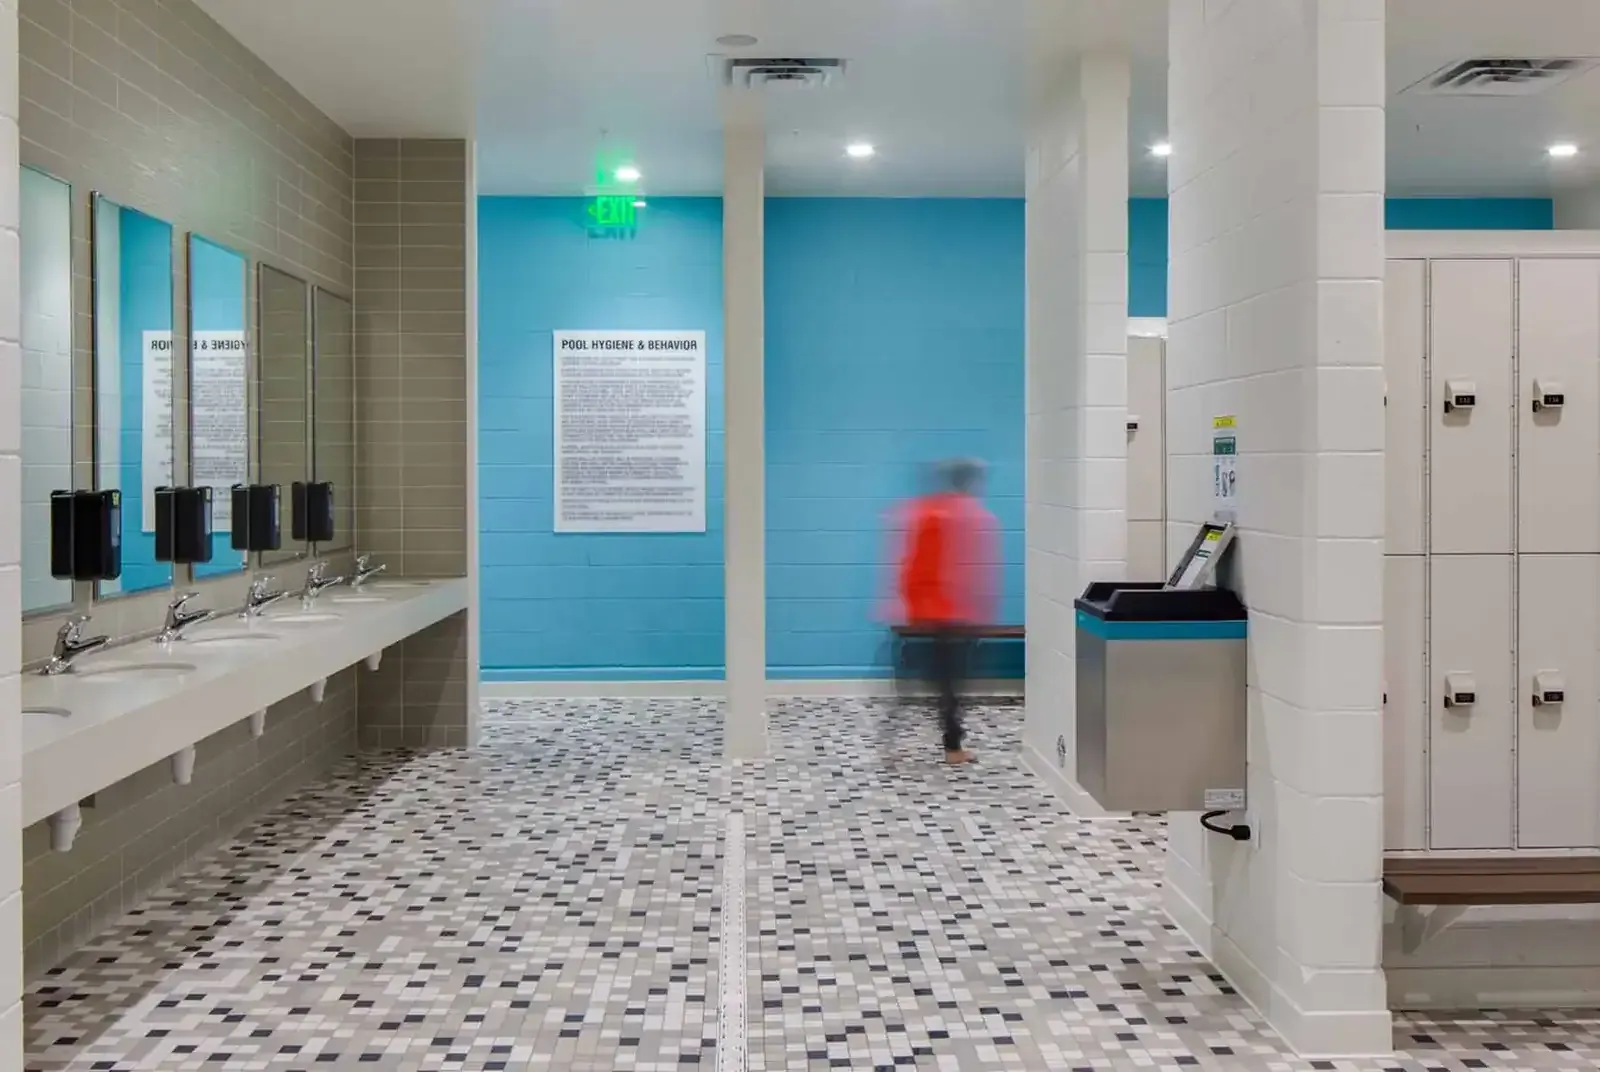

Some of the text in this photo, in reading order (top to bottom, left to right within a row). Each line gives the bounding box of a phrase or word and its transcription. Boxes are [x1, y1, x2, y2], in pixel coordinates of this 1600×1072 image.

[597, 196, 636, 225] EXIT
[561, 339, 697, 350] POOL HYGIENE & BEHAVIOR
